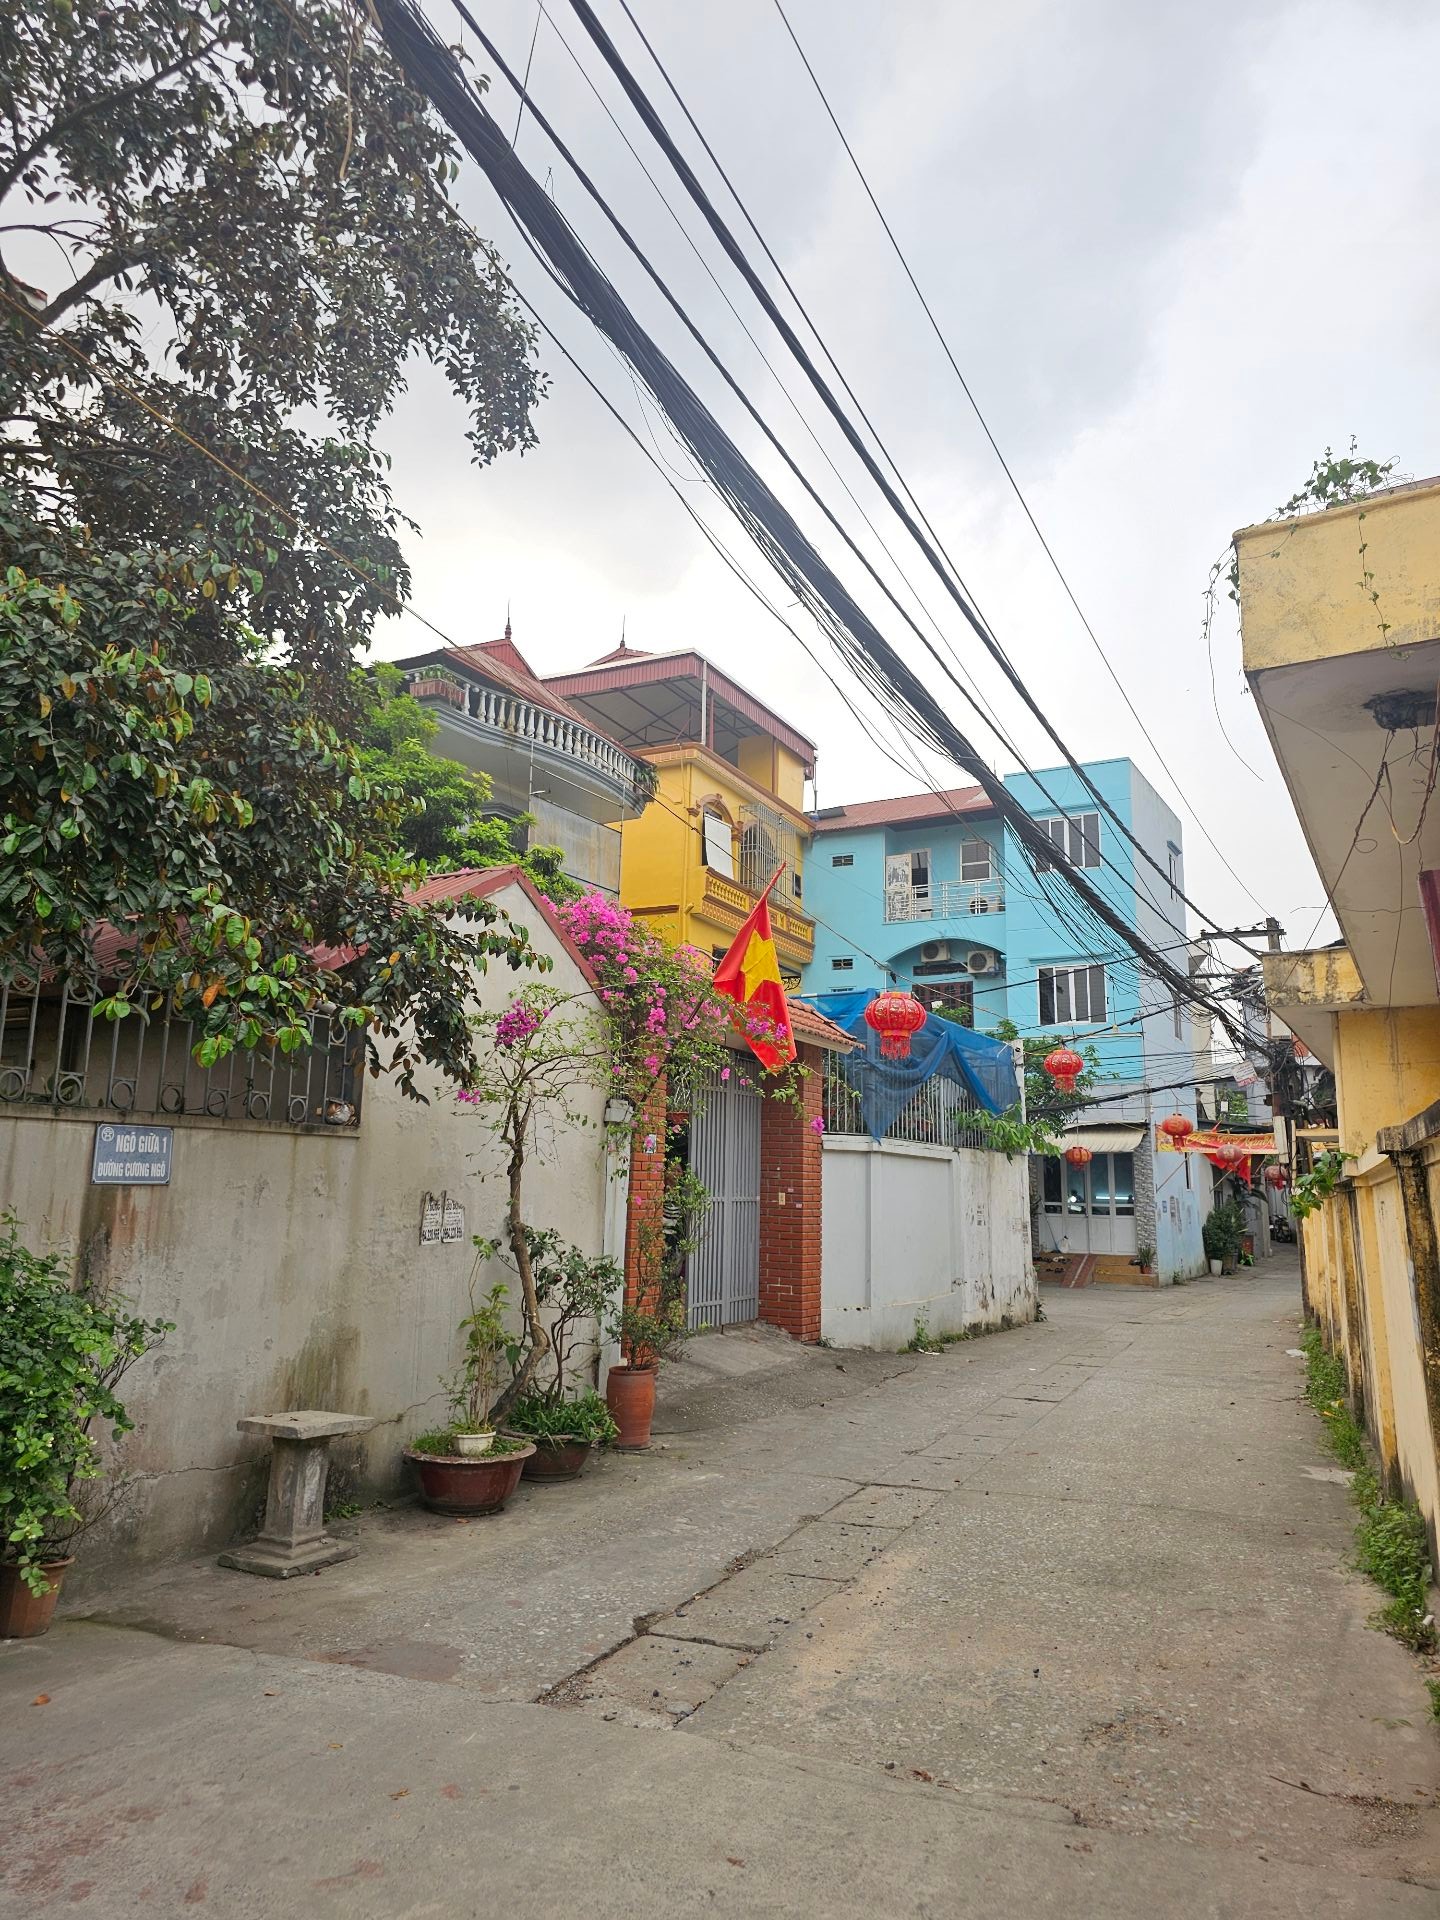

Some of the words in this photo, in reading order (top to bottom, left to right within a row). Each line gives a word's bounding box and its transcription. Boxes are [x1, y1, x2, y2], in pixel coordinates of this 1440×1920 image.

[115, 1131, 136, 1153] NGÕ
[138, 1132, 160, 1154] GIỮA
[162, 1136, 168, 1154] 1
[97, 1159, 124, 1177] ĐƯỜNG
[125, 1161, 150, 1177] CƯƠNG
